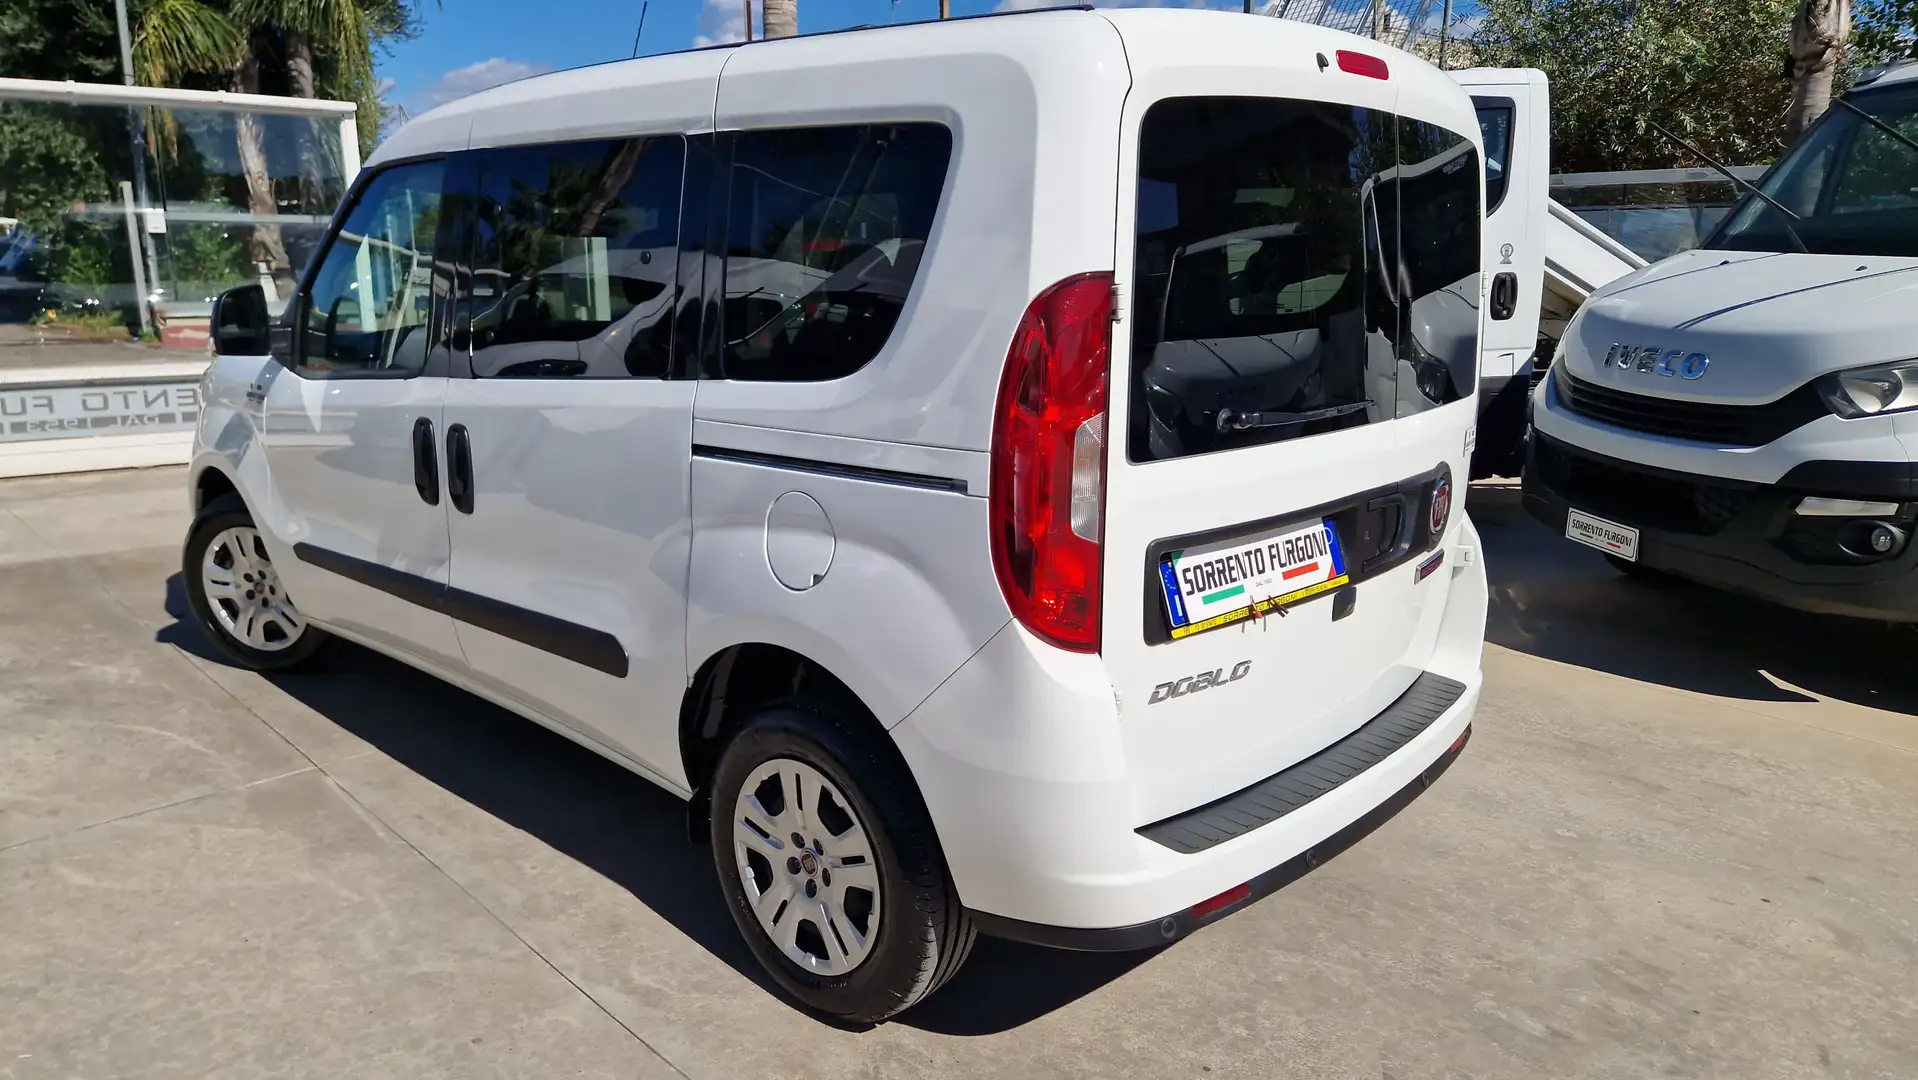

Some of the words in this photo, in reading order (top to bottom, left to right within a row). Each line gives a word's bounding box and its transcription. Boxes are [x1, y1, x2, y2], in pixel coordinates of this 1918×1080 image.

[1603, 342, 1710, 380] IVECO
[1572, 519, 1604, 537] SORRENTO
[1603, 529, 1633, 547] FURGONI
[1182, 547, 1266, 596] SORRENTO
[1267, 530, 1328, 571] FURGONI
[1223, 604, 1265, 622] SORREO
[1147, 659, 1252, 705] DOBLO
